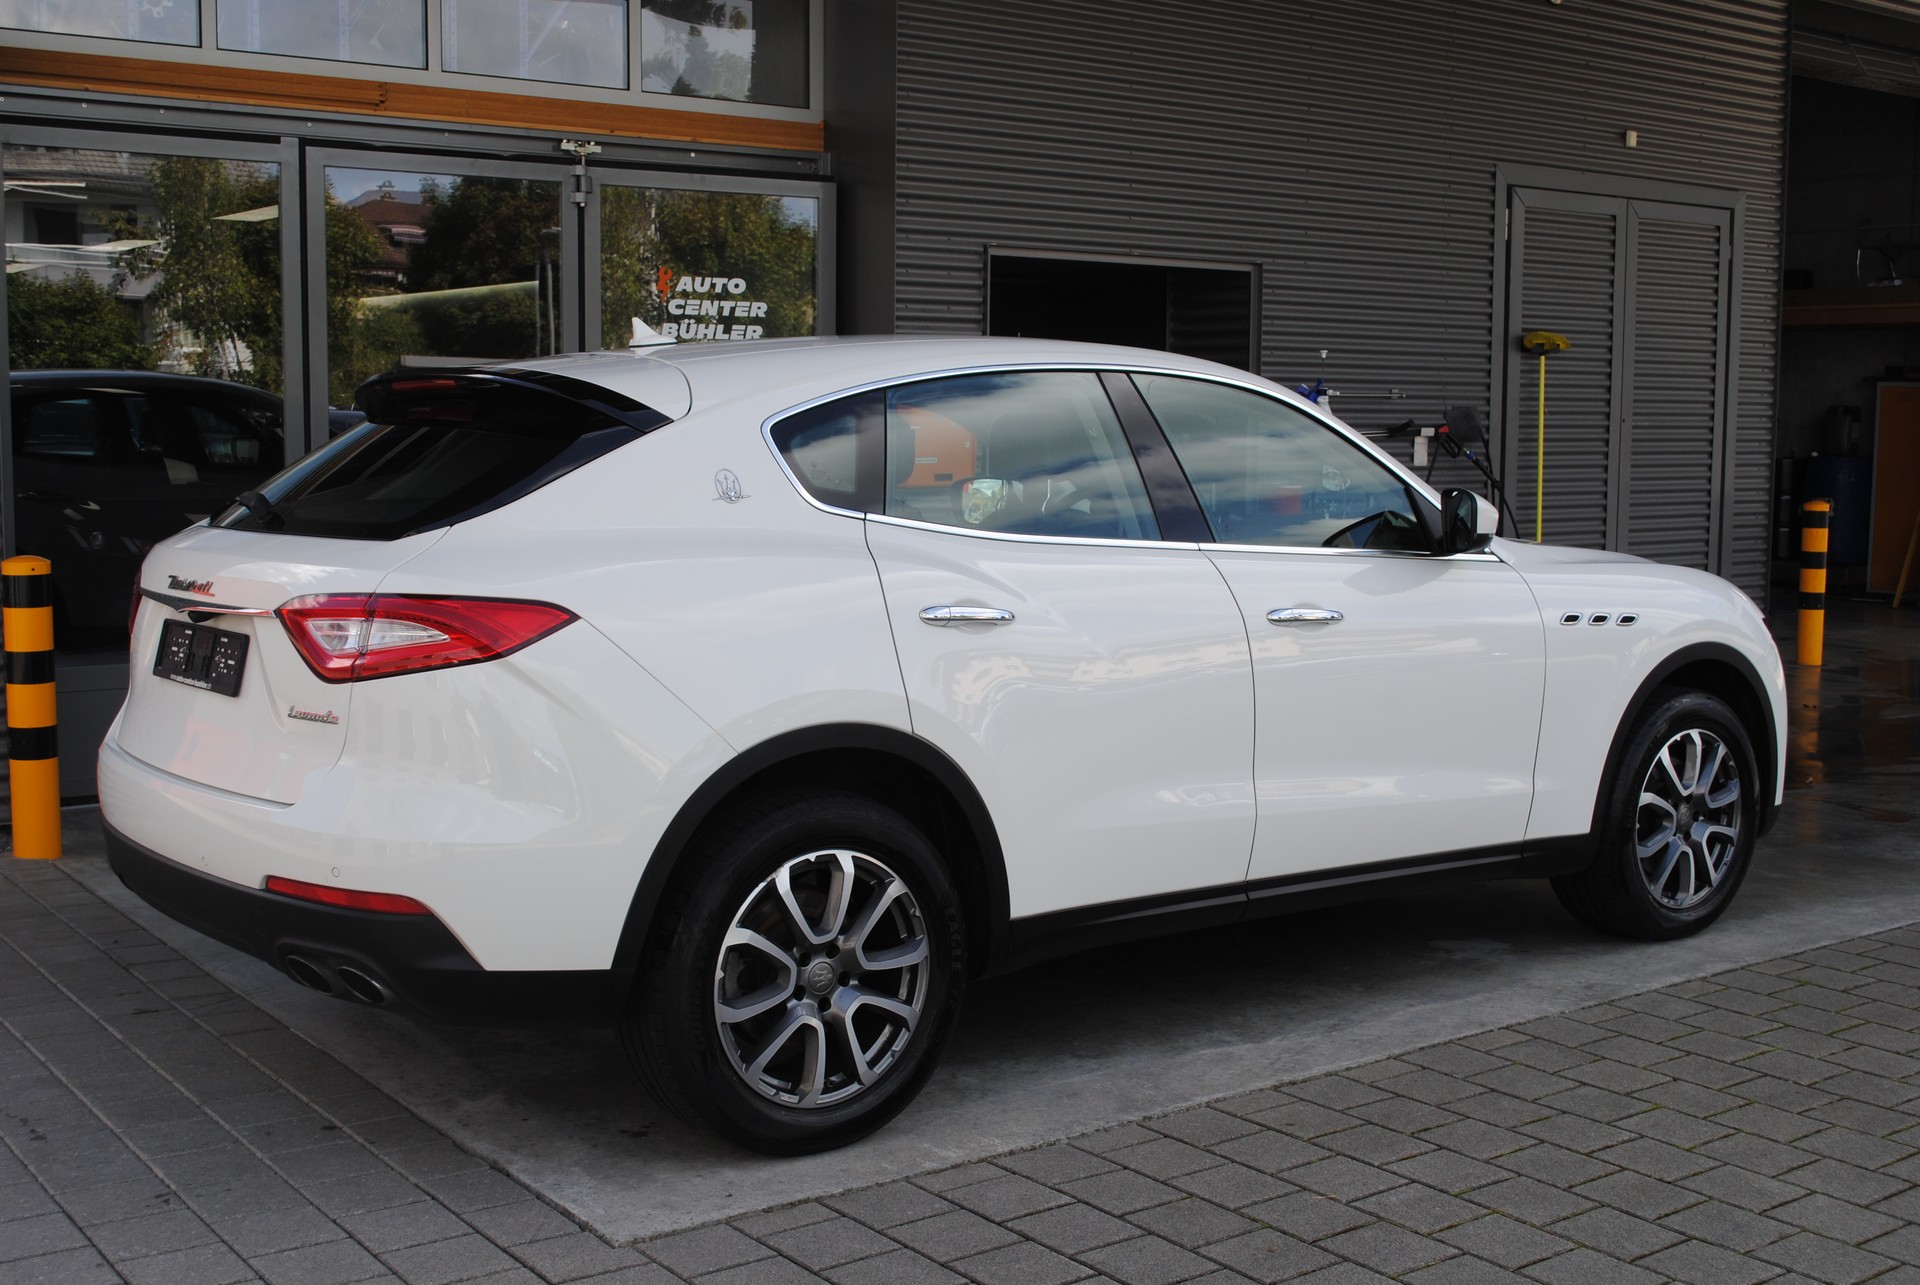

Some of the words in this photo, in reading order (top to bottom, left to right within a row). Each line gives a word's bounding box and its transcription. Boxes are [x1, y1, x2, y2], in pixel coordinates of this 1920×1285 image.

[676, 275, 746, 294] AUTO
[668, 299, 768, 318] CENTER
[660, 319, 763, 340] BÜHLER
